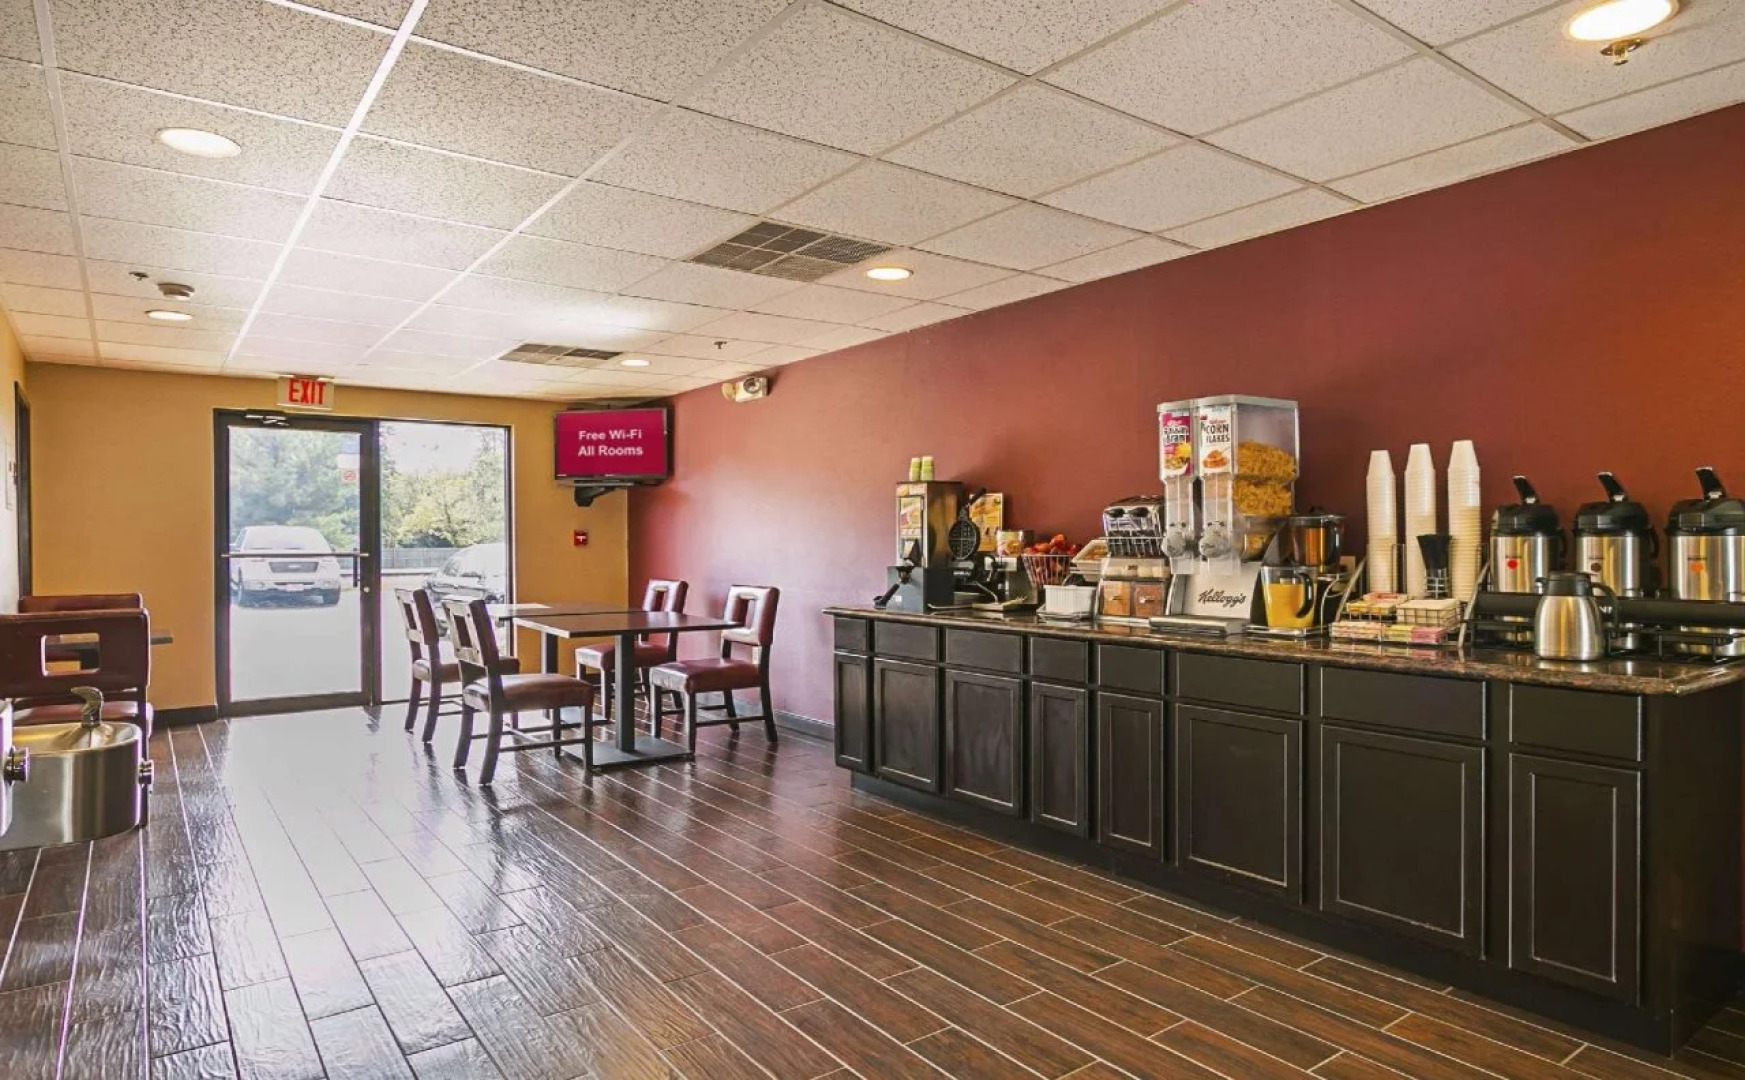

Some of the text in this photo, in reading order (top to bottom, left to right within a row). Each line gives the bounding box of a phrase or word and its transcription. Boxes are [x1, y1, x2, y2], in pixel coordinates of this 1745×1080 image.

[288, 379, 326, 405] EXIT
[578, 428, 642, 440] Free Wi-Fi
[1206, 423, 1229, 434] CORN
[578, 445, 644, 456] All Rooms
[1197, 588, 1247, 607] Kellogg's
